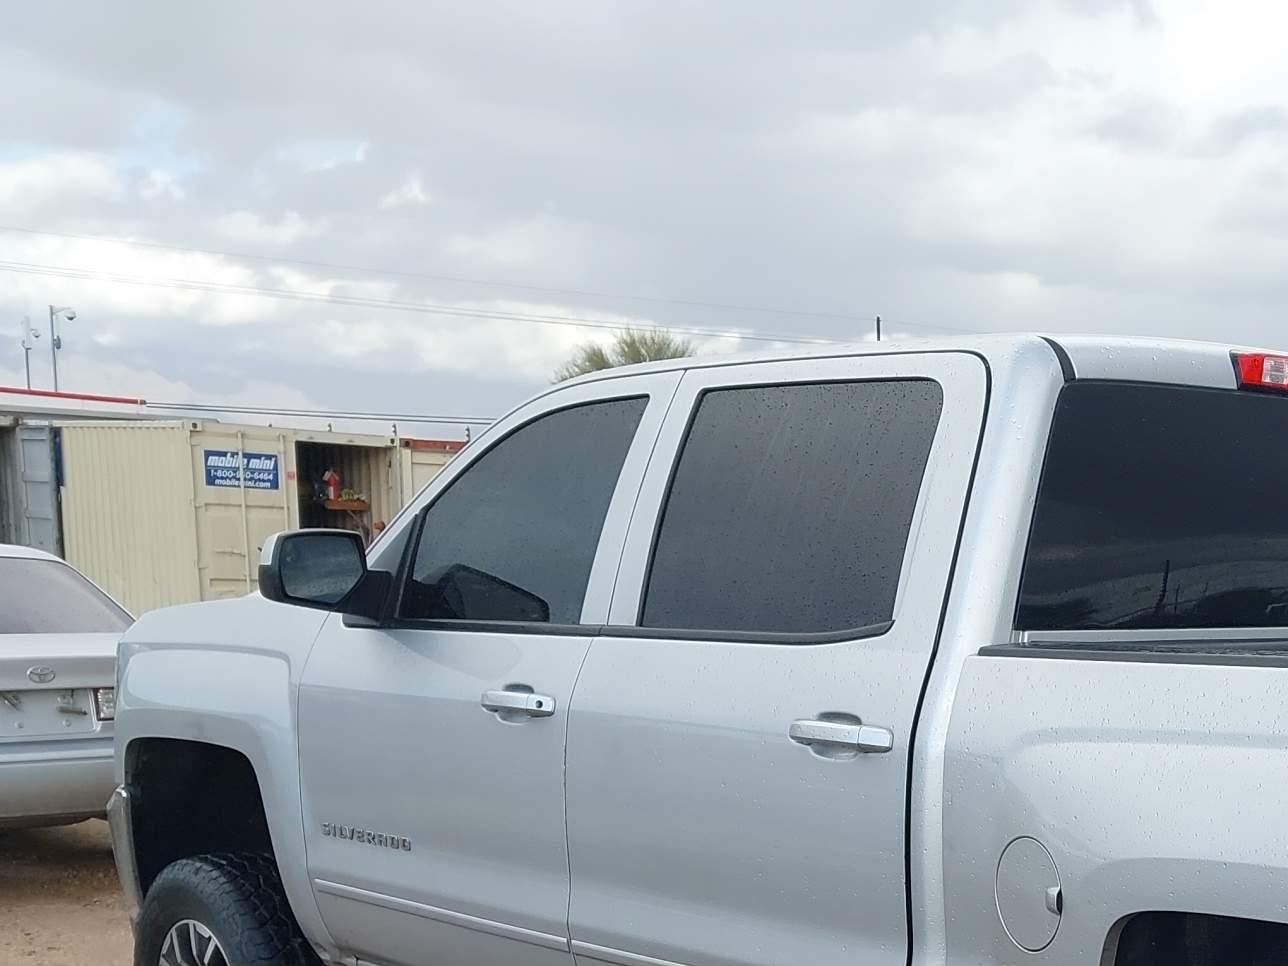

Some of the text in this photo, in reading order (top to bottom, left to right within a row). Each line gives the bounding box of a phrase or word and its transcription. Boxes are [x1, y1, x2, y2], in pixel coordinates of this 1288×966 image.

[207, 452, 275, 469] mobile mini
[210, 469, 273, 481] 1-800-90-6464
[321, 822, 412, 852] SILVERADO
